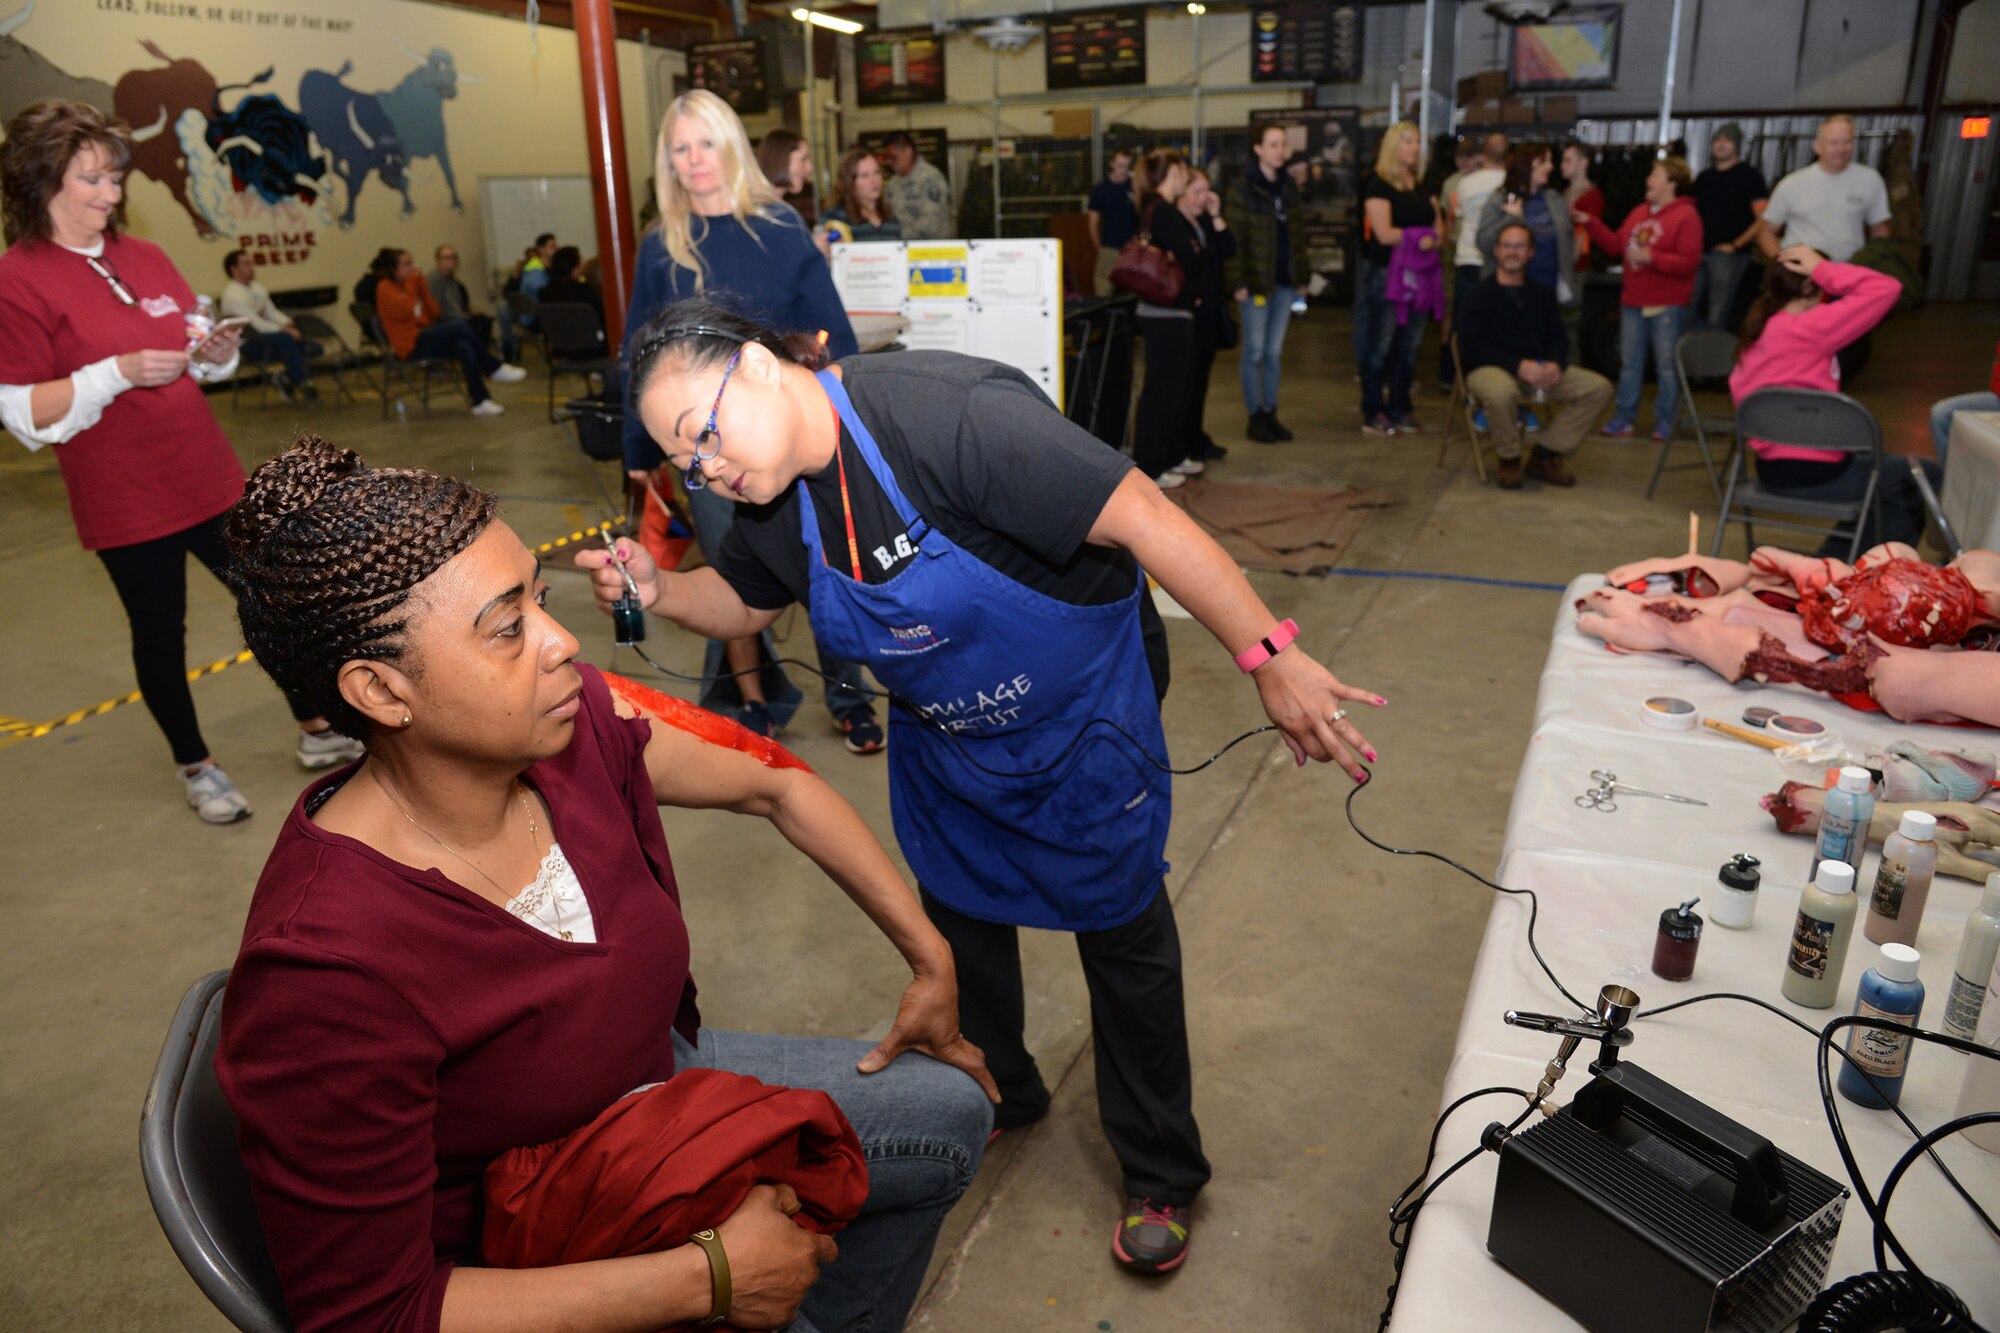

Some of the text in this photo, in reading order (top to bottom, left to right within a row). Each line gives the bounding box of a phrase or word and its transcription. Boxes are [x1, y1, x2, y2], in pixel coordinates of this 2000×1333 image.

[230, 9, 252, 22] GET
[300, 15, 322, 29] THE
[239, 232, 317, 247] PRIME
[254, 249, 310, 266] BEEF
[872, 533, 920, 571] B.G.
